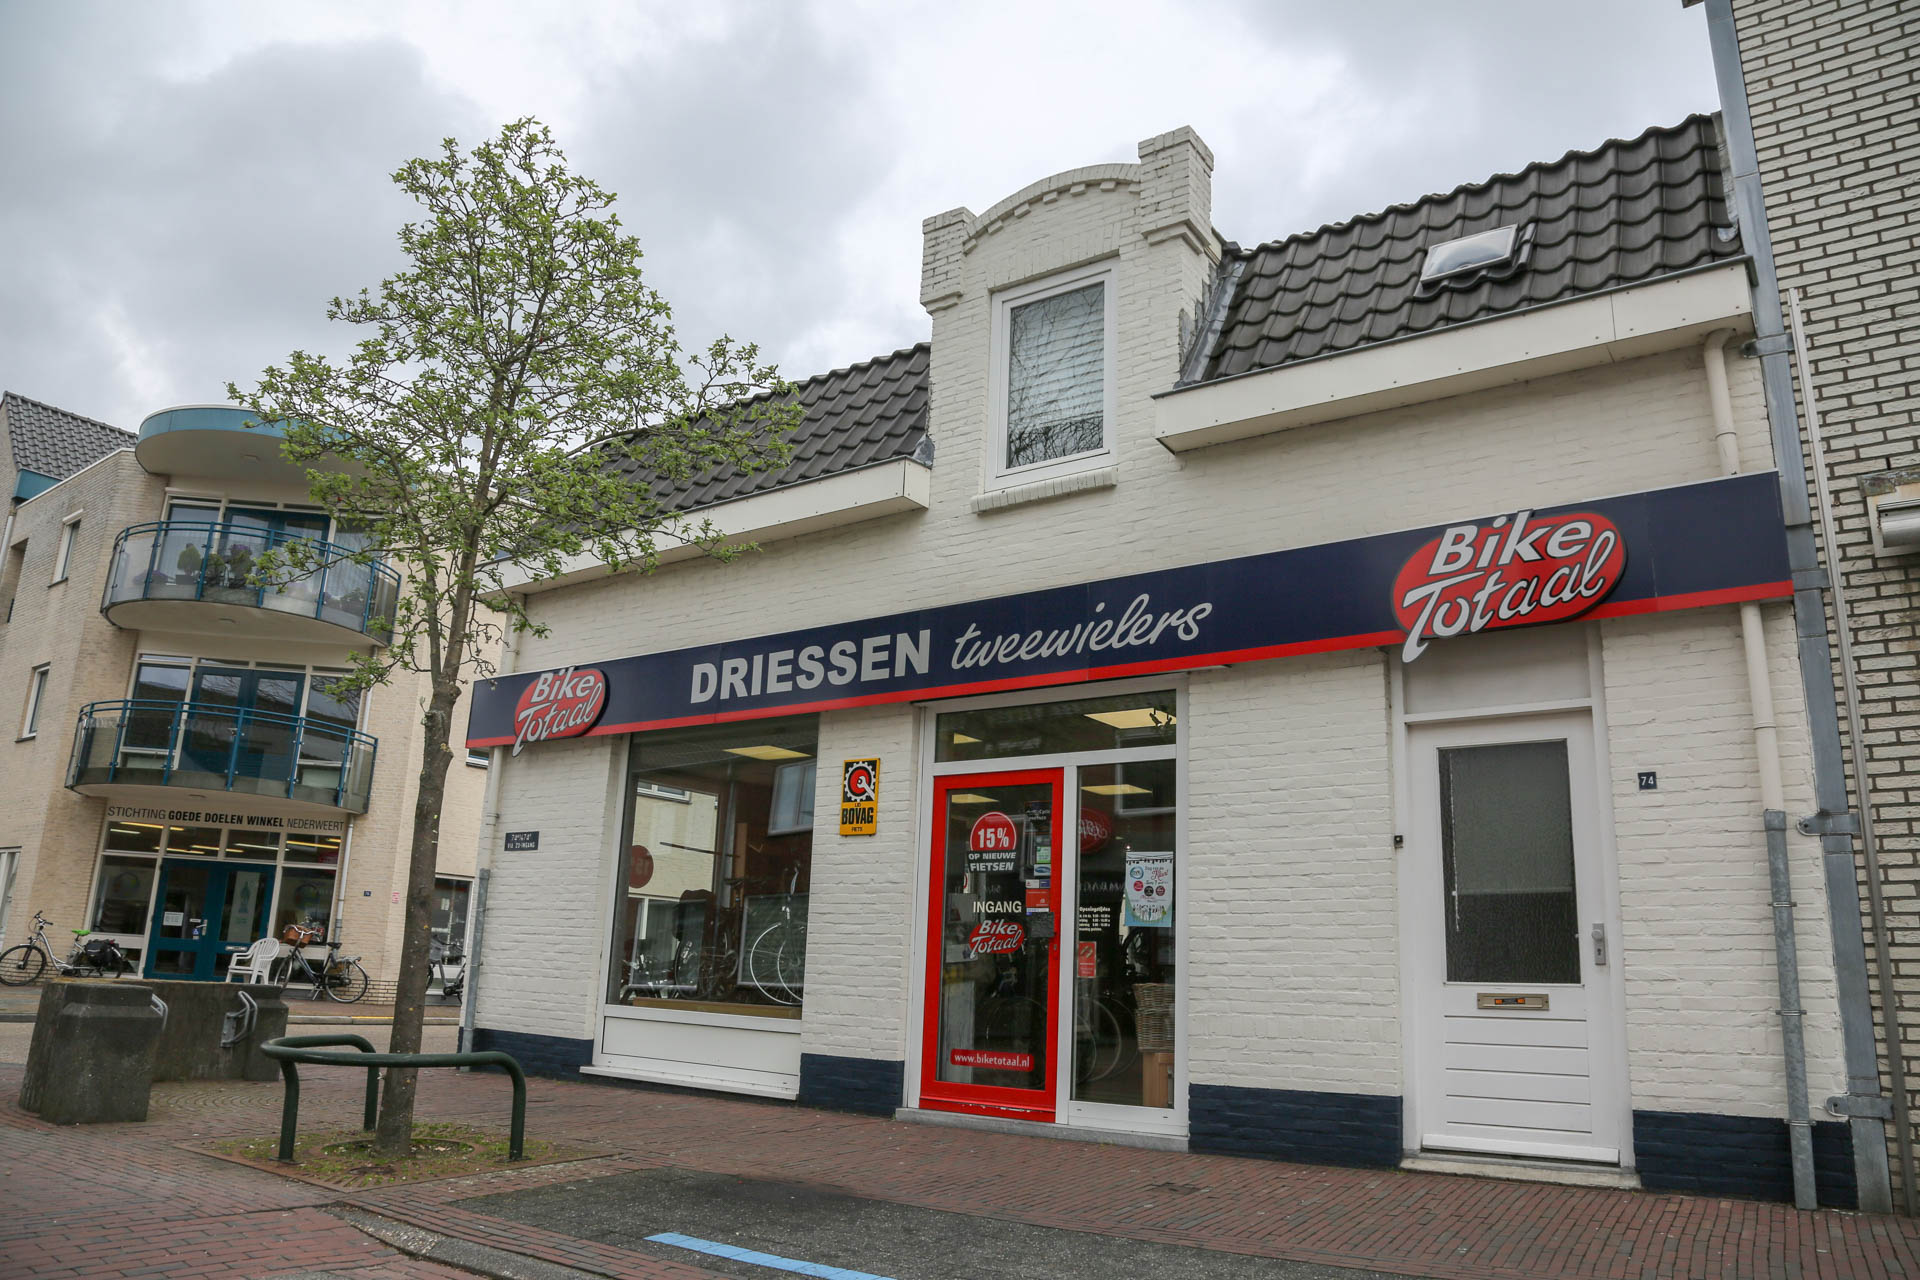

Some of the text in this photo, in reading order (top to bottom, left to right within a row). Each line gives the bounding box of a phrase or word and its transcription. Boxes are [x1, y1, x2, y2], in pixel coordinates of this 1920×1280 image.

[1428, 510, 1593, 576] Bike
[1402, 530, 1616, 663] Totaal
[690, 593, 1213, 704] DRIESSEN tweewielers
[531, 666, 596, 702] Bike
[513, 682, 602, 756] Totaal
[1640, 776, 1654, 786] 74
[107, 806, 345, 831] STICHTING GOEDE DOELEN WINKEL NEDERWEERT
[842, 807, 874, 825] BOVAG
[978, 827, 1010, 849] 15%
[968, 852, 1016, 861] OP NIEUWE
[970, 862, 1014, 872] FIETSEN
[973, 901, 1022, 913] INGANG
[978, 918, 1018, 935] Bike
[969, 929, 1022, 960] Totaal
[954, 1053, 1030, 1067] www.biketotaal.nl
